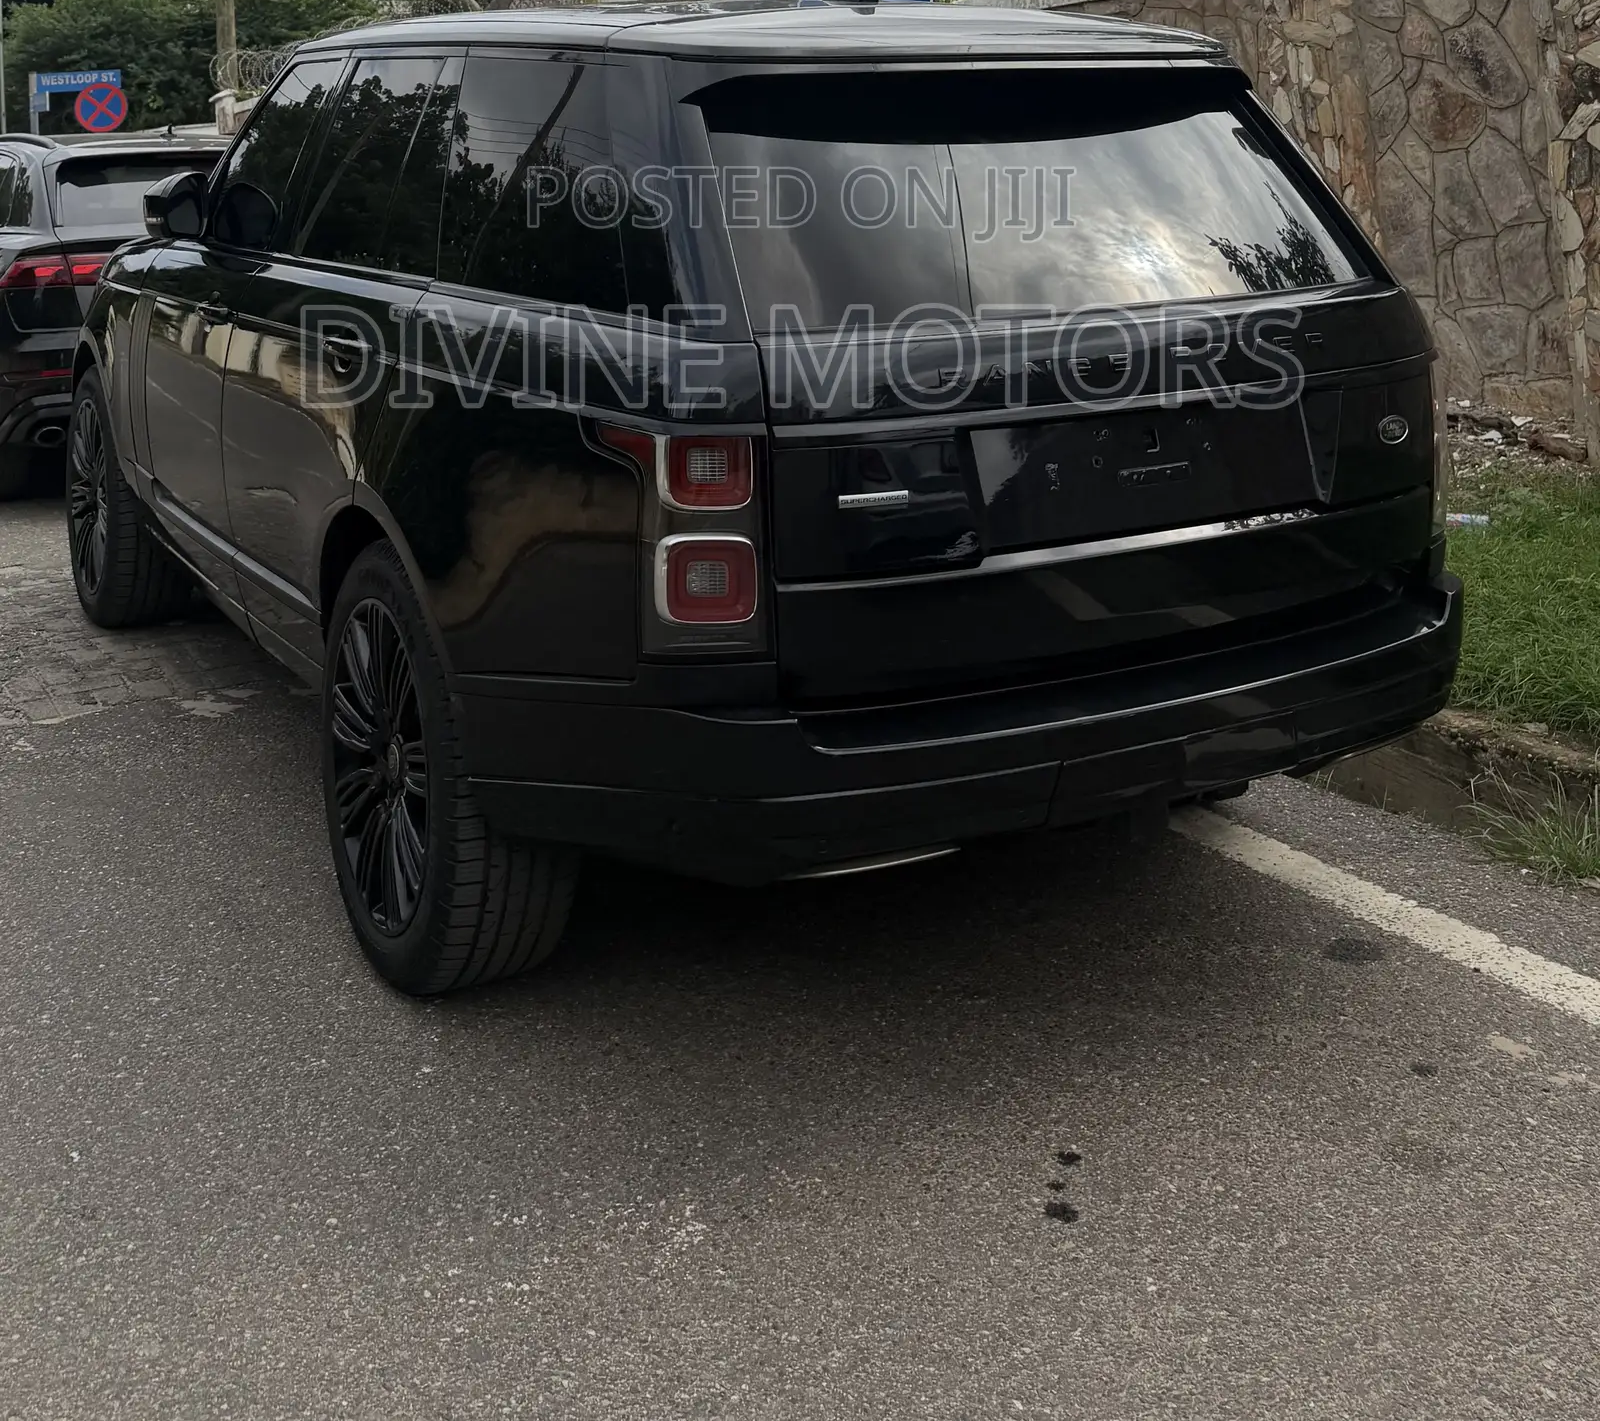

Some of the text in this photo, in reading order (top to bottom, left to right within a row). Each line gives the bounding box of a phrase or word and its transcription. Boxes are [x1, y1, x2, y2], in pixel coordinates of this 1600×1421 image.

[41, 72, 116, 86] WESTLOOP ST.
[840, 494, 907, 505] SUPERCHARGED
